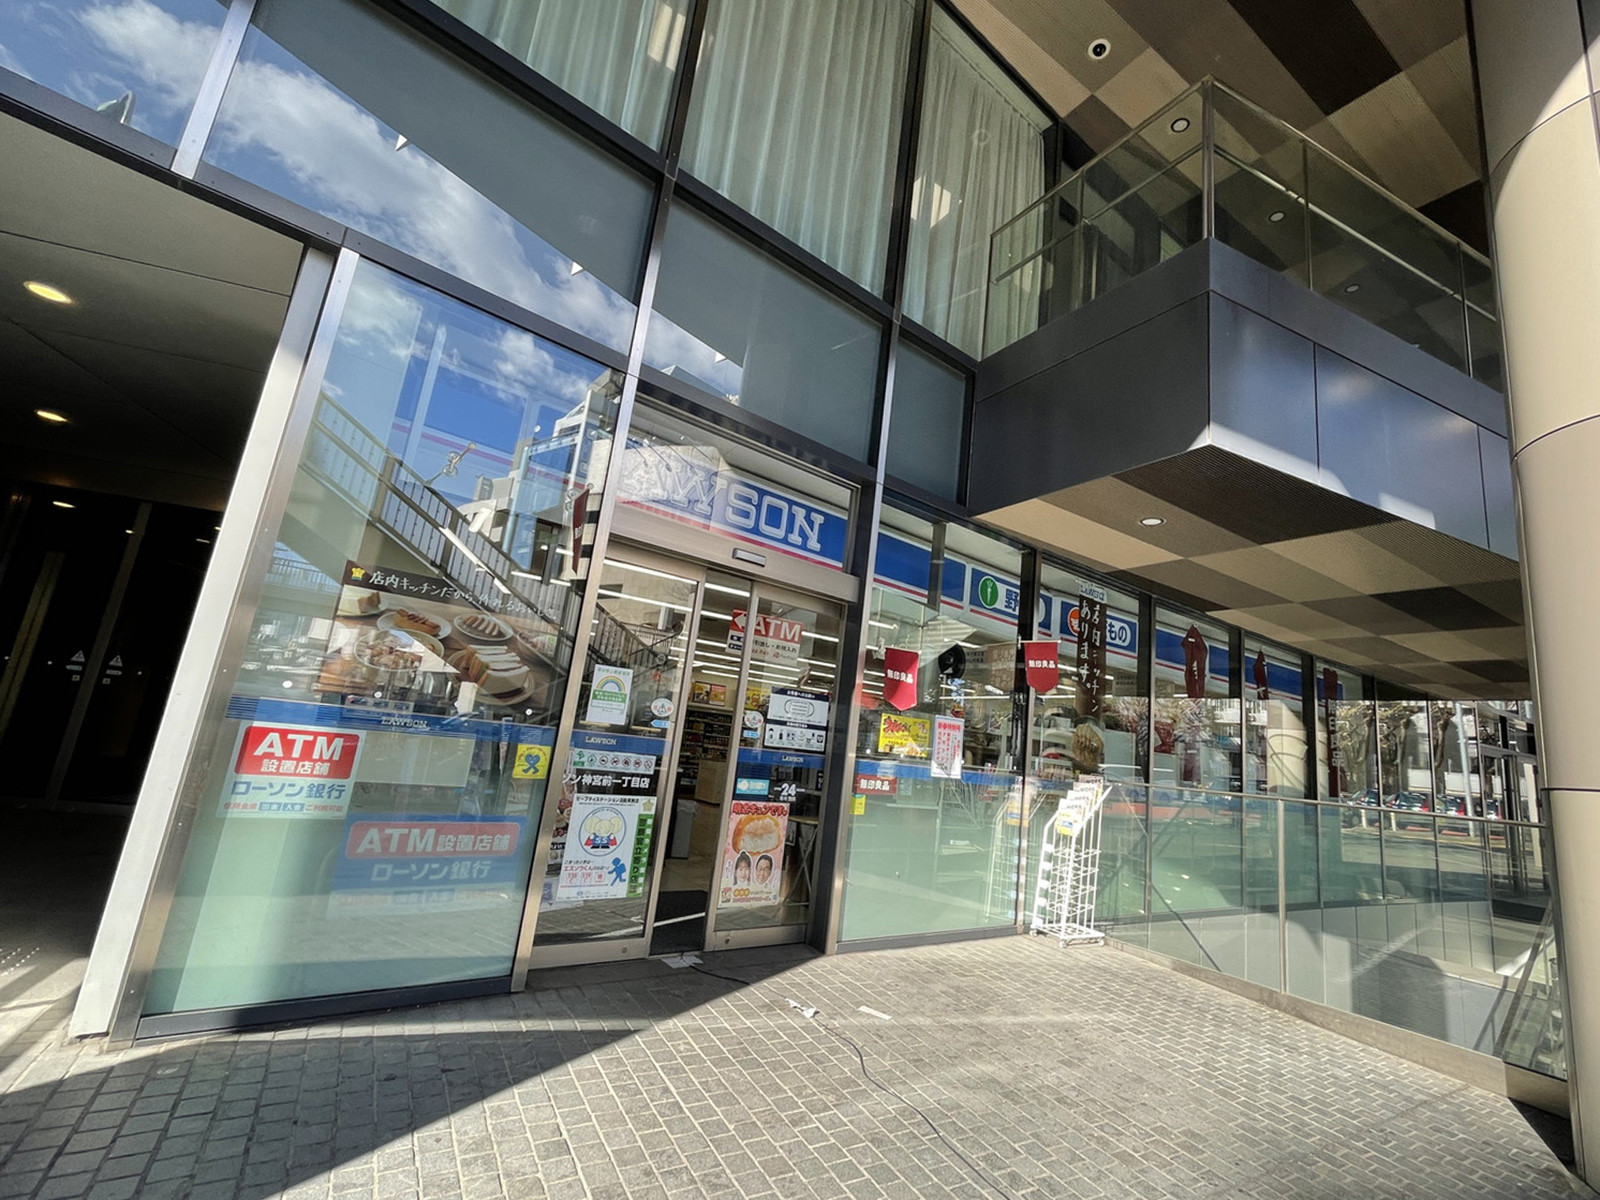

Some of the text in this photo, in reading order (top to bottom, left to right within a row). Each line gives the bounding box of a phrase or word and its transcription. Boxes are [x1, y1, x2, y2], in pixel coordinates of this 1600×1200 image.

[618, 450, 825, 552] WSON
[1004, 588, 1019, 612] 野
[755, 616, 801, 642] ATM
[1107, 621, 1128, 643] もの
[1028, 660, 1055, 669] 無印良品
[886, 668, 914, 684] 無印良品
[253, 732, 344, 761] ATM
[260, 759, 331, 776] 設置店舗
[231, 781, 346, 800] ローソン銀行
[781, 783, 796, 797] 24
[860, 779, 890, 791] 無印良品
[356, 828, 510, 853] ATM設置店舗
[371, 861, 491, 881] ローソン銀行
